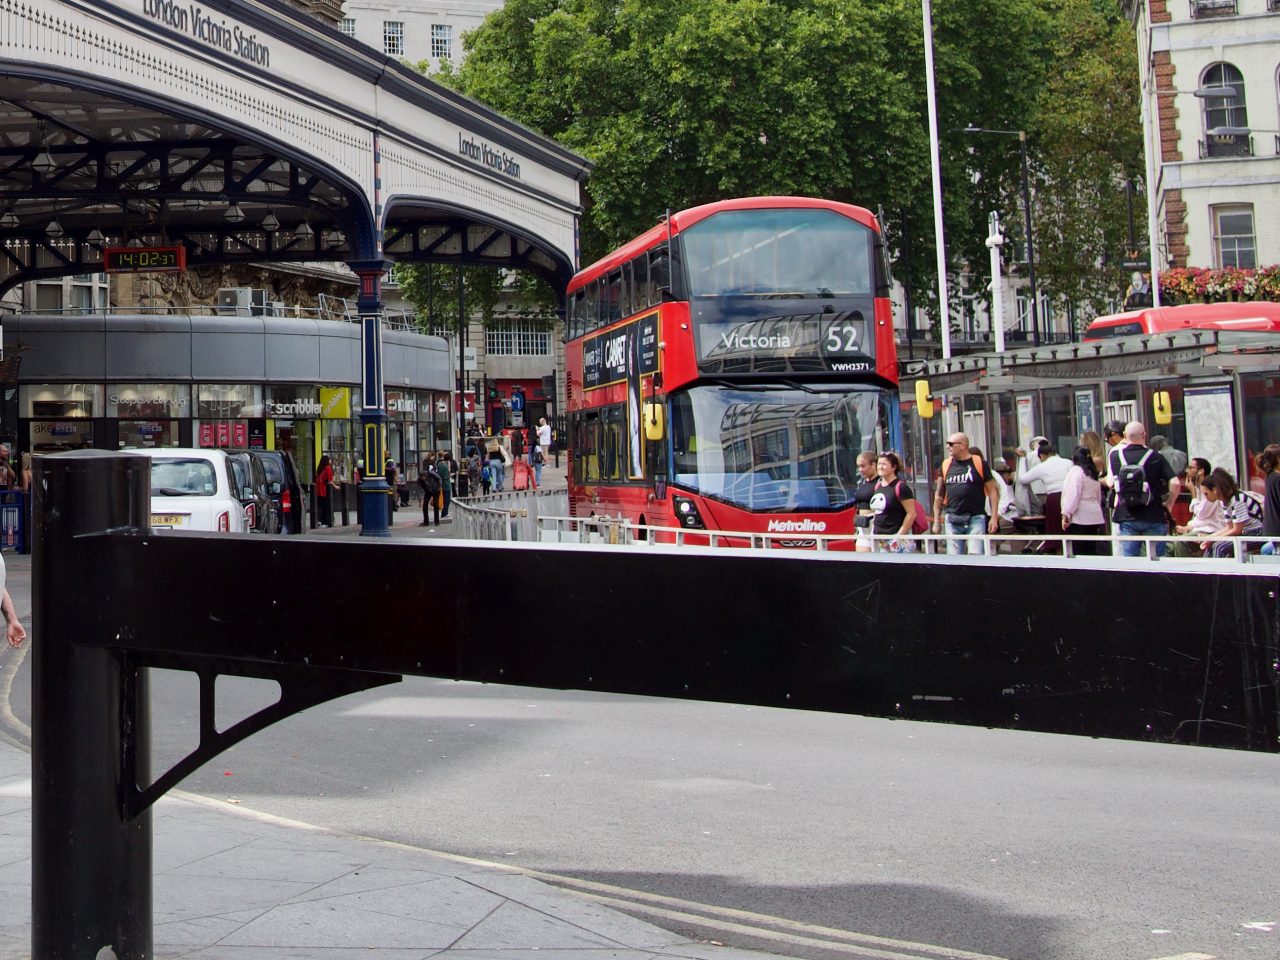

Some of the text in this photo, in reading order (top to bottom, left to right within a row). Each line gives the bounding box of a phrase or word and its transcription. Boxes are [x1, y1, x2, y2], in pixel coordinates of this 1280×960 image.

[190, 4, 232, 51] Victoria
[233, 26, 270, 67] Station
[458, 131, 521, 179] London Victoria Station
[722, 326, 859, 352] Victoria 52
[831, 362, 869, 371] VWH2371
[110, 394, 187, 409] Superdrug
[276, 398, 322, 414] scribbler
[767, 519, 827, 532] Metroline
